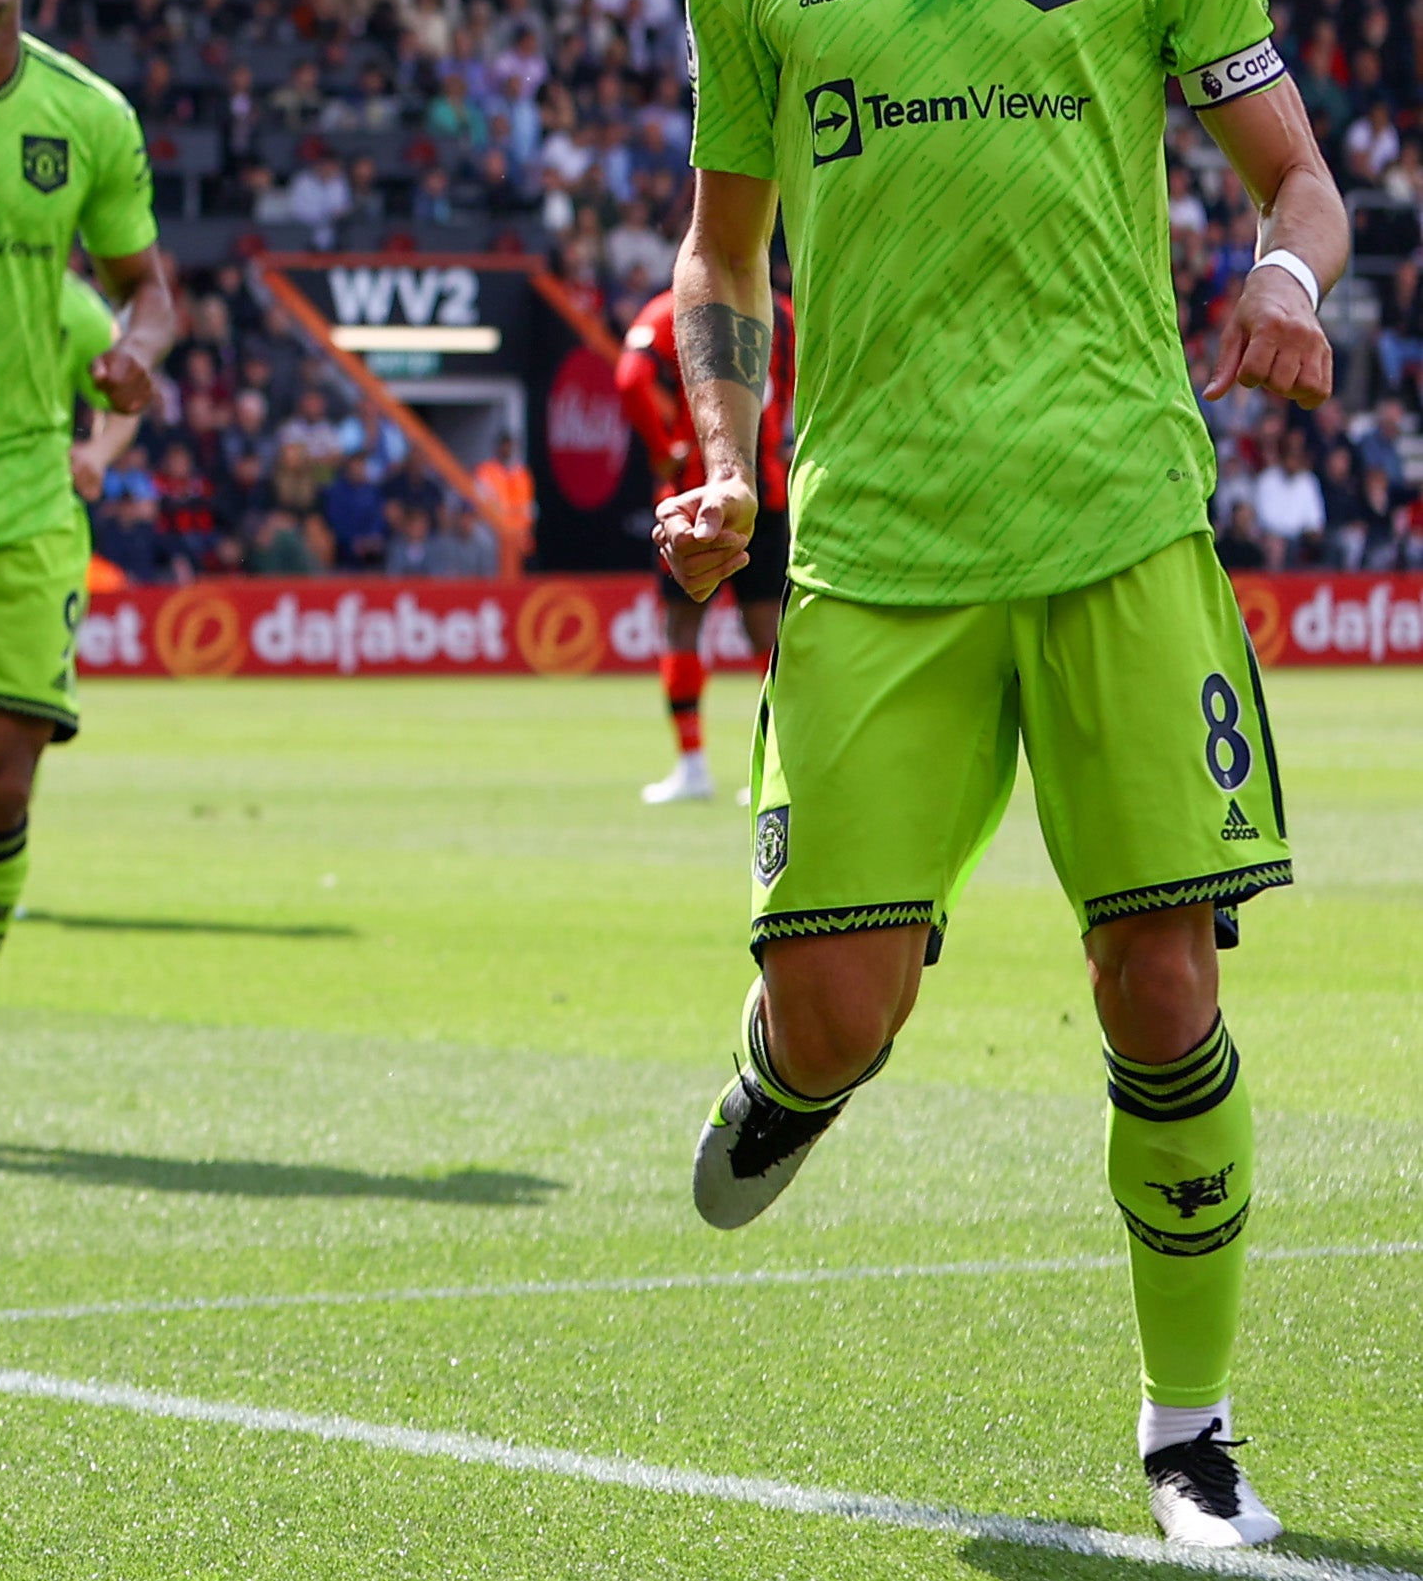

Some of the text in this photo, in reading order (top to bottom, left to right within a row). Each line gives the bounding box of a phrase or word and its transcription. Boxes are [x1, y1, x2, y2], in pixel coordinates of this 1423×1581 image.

[861, 83, 1092, 130] TeamViewer
[327, 266, 480, 326] WV2
[250, 593, 506, 672] dafabet
[1201, 672, 1252, 792] 8
[1220, 824, 1260, 842] adidas
